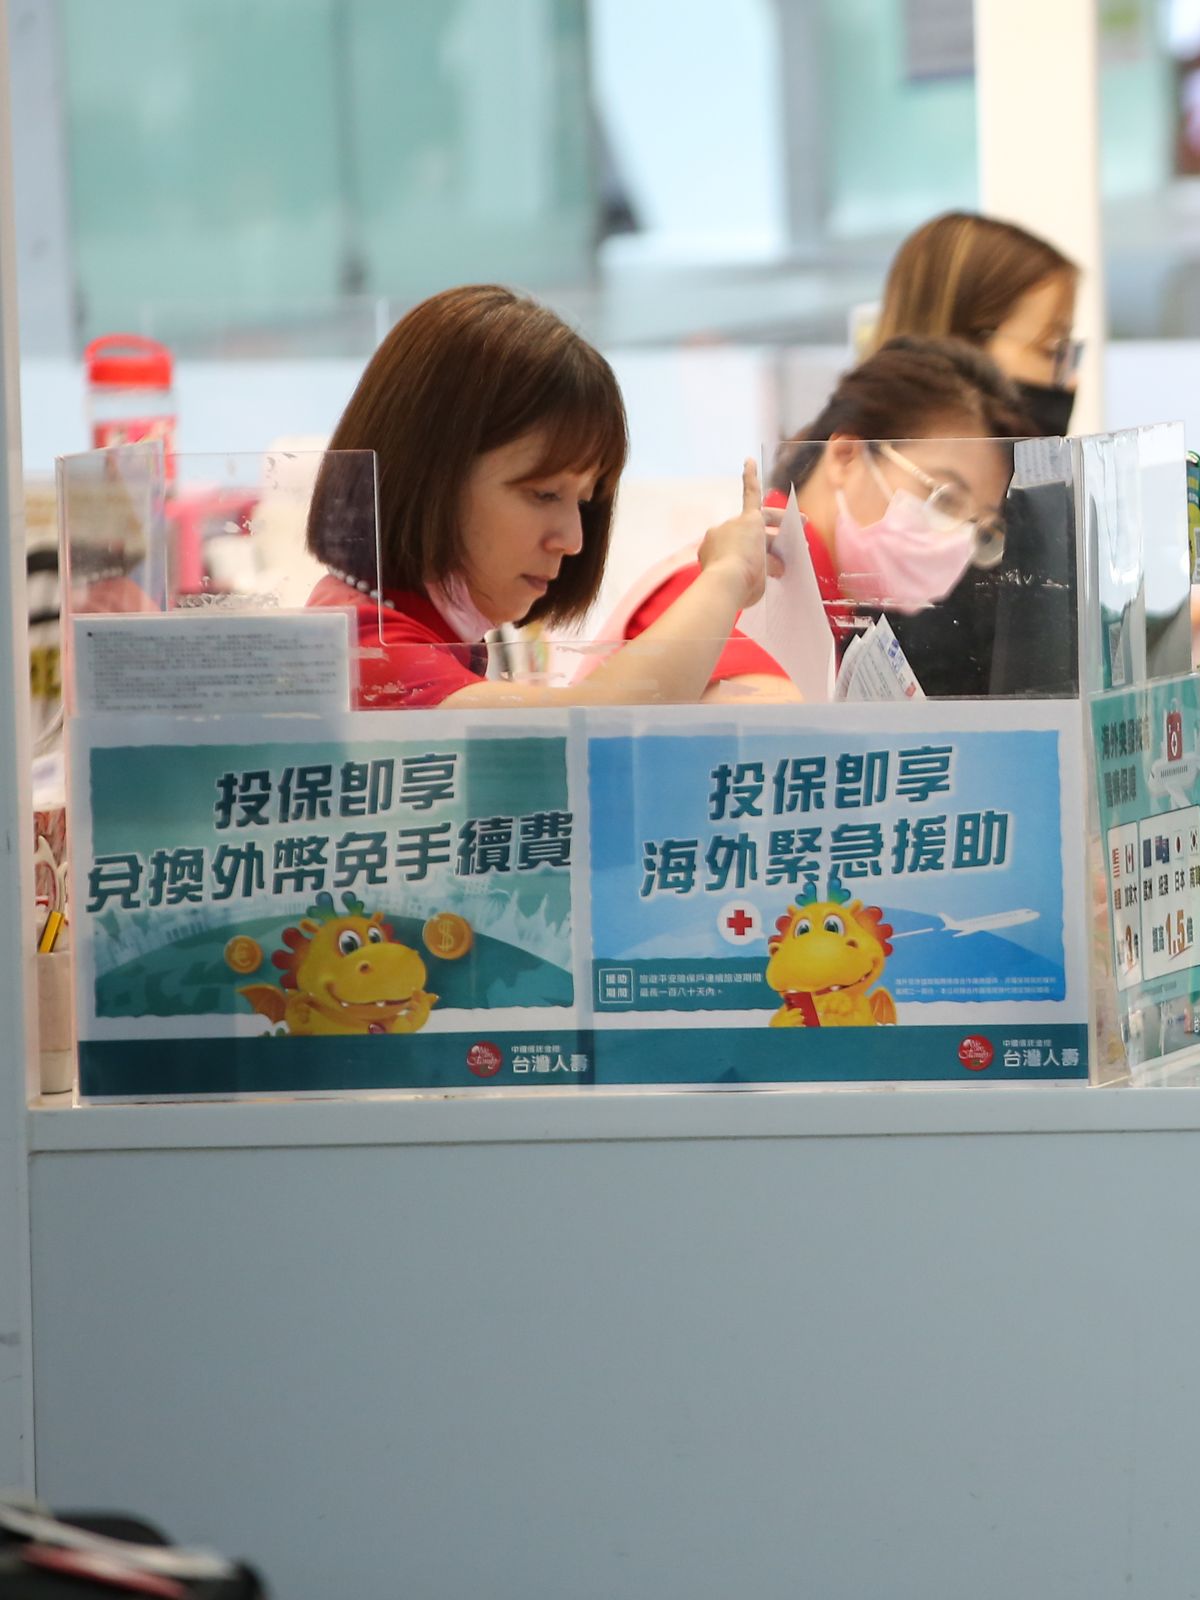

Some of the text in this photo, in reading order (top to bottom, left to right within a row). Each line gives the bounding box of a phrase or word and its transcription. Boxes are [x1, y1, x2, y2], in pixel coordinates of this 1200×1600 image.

[214, 752, 458, 829] 投保即享
[709, 745, 953, 820] 投保即享
[87, 811, 573, 912] 兌換外幣免手續費
[640, 810, 1009, 898] 海外緊急援助
[1174, 869, 1185, 893] 日本
[512, 1054, 588, 1073] 台灣人壽
[1003, 1048, 1079, 1067] 台灣人壽
